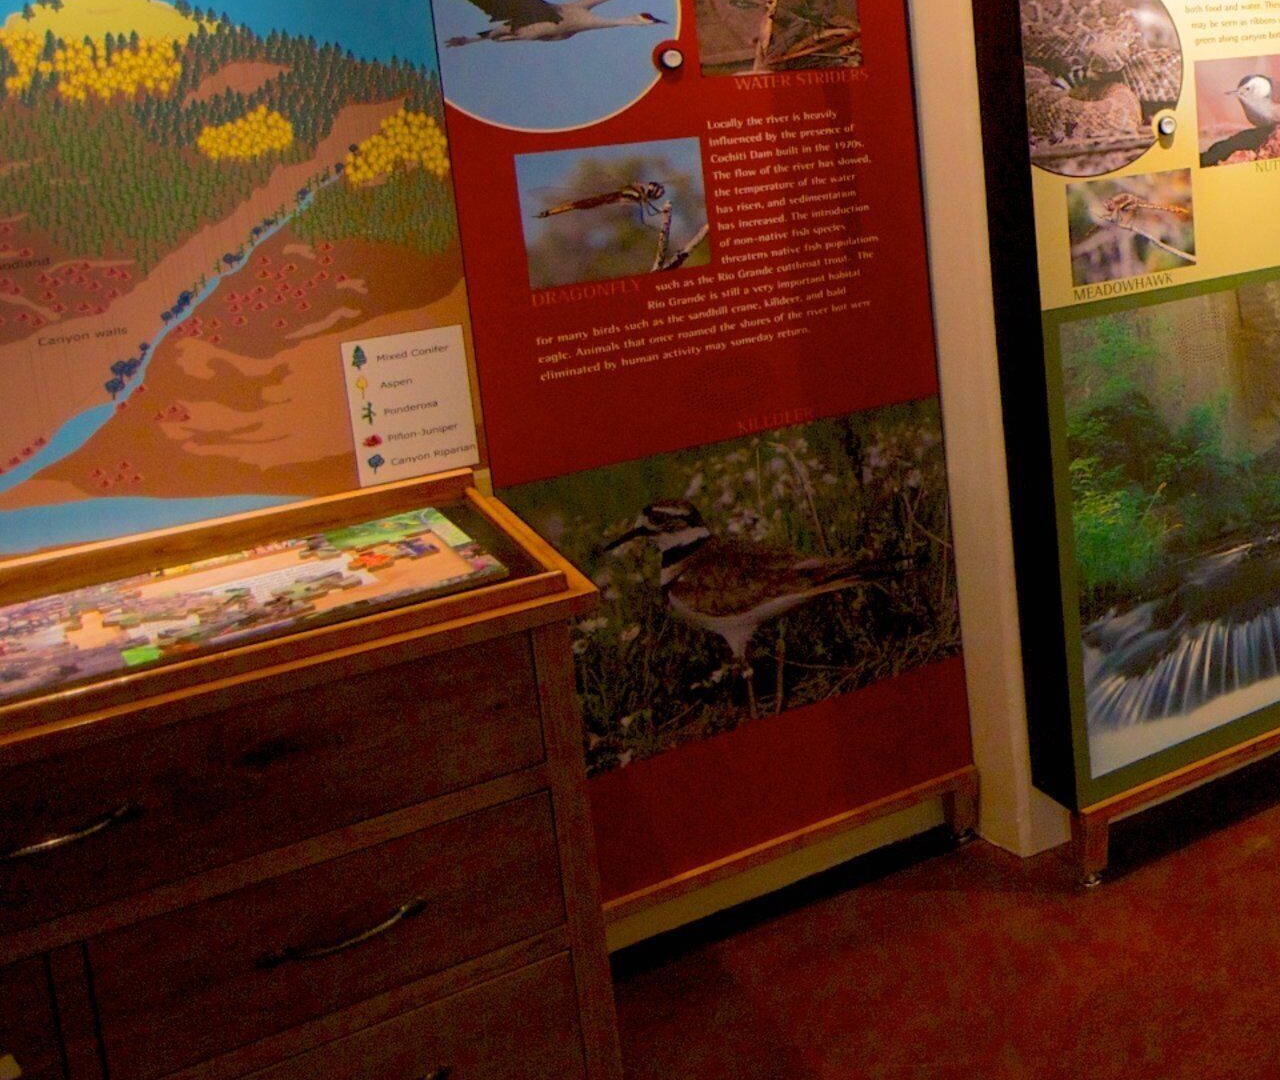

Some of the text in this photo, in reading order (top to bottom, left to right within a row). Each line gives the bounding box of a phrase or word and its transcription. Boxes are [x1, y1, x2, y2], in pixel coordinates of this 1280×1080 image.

[735, 69, 869, 90] WATER STRIDERS
[531, 278, 642, 308] DRAGONFLY
[1073, 272, 1173, 302] MEADOWHAWK
[38, 326, 127, 346] Canyon walls
[377, 344, 448, 362] Mixed Conifer
[380, 377, 413, 389] Aspen
[383, 400, 438, 416] Ponderosa
[390, 443, 477, 467] Canyon Riparian
